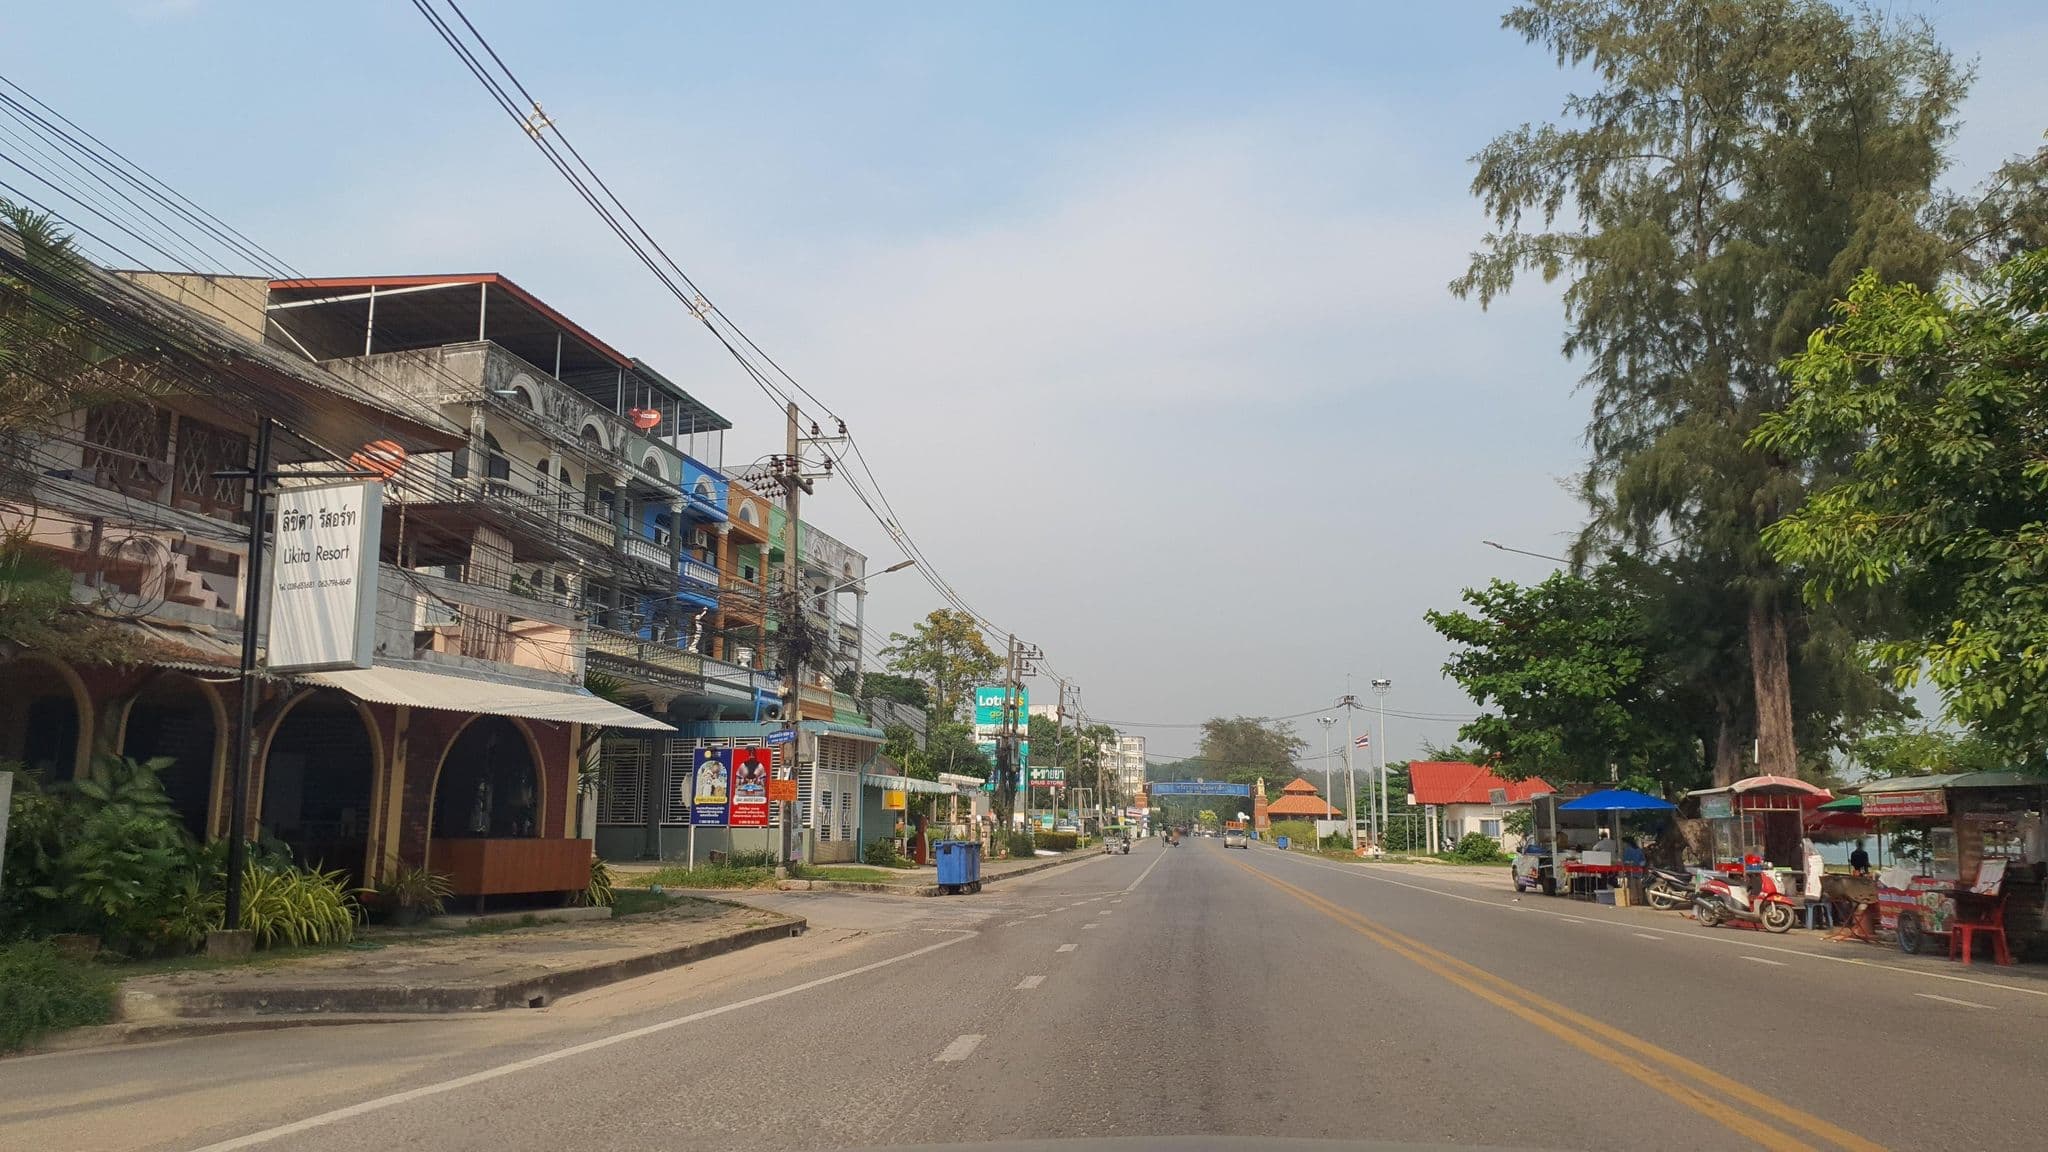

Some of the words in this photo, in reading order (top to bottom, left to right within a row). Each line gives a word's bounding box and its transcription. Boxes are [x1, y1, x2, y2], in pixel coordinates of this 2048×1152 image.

[283, 509, 313, 532] ลิขิตา
[320, 504, 355, 528] รีสอร์ท
[283, 546, 310, 564] Likita
[315, 545, 350, 561] Resort
[1040, 768, 1064, 779] ขายยา
